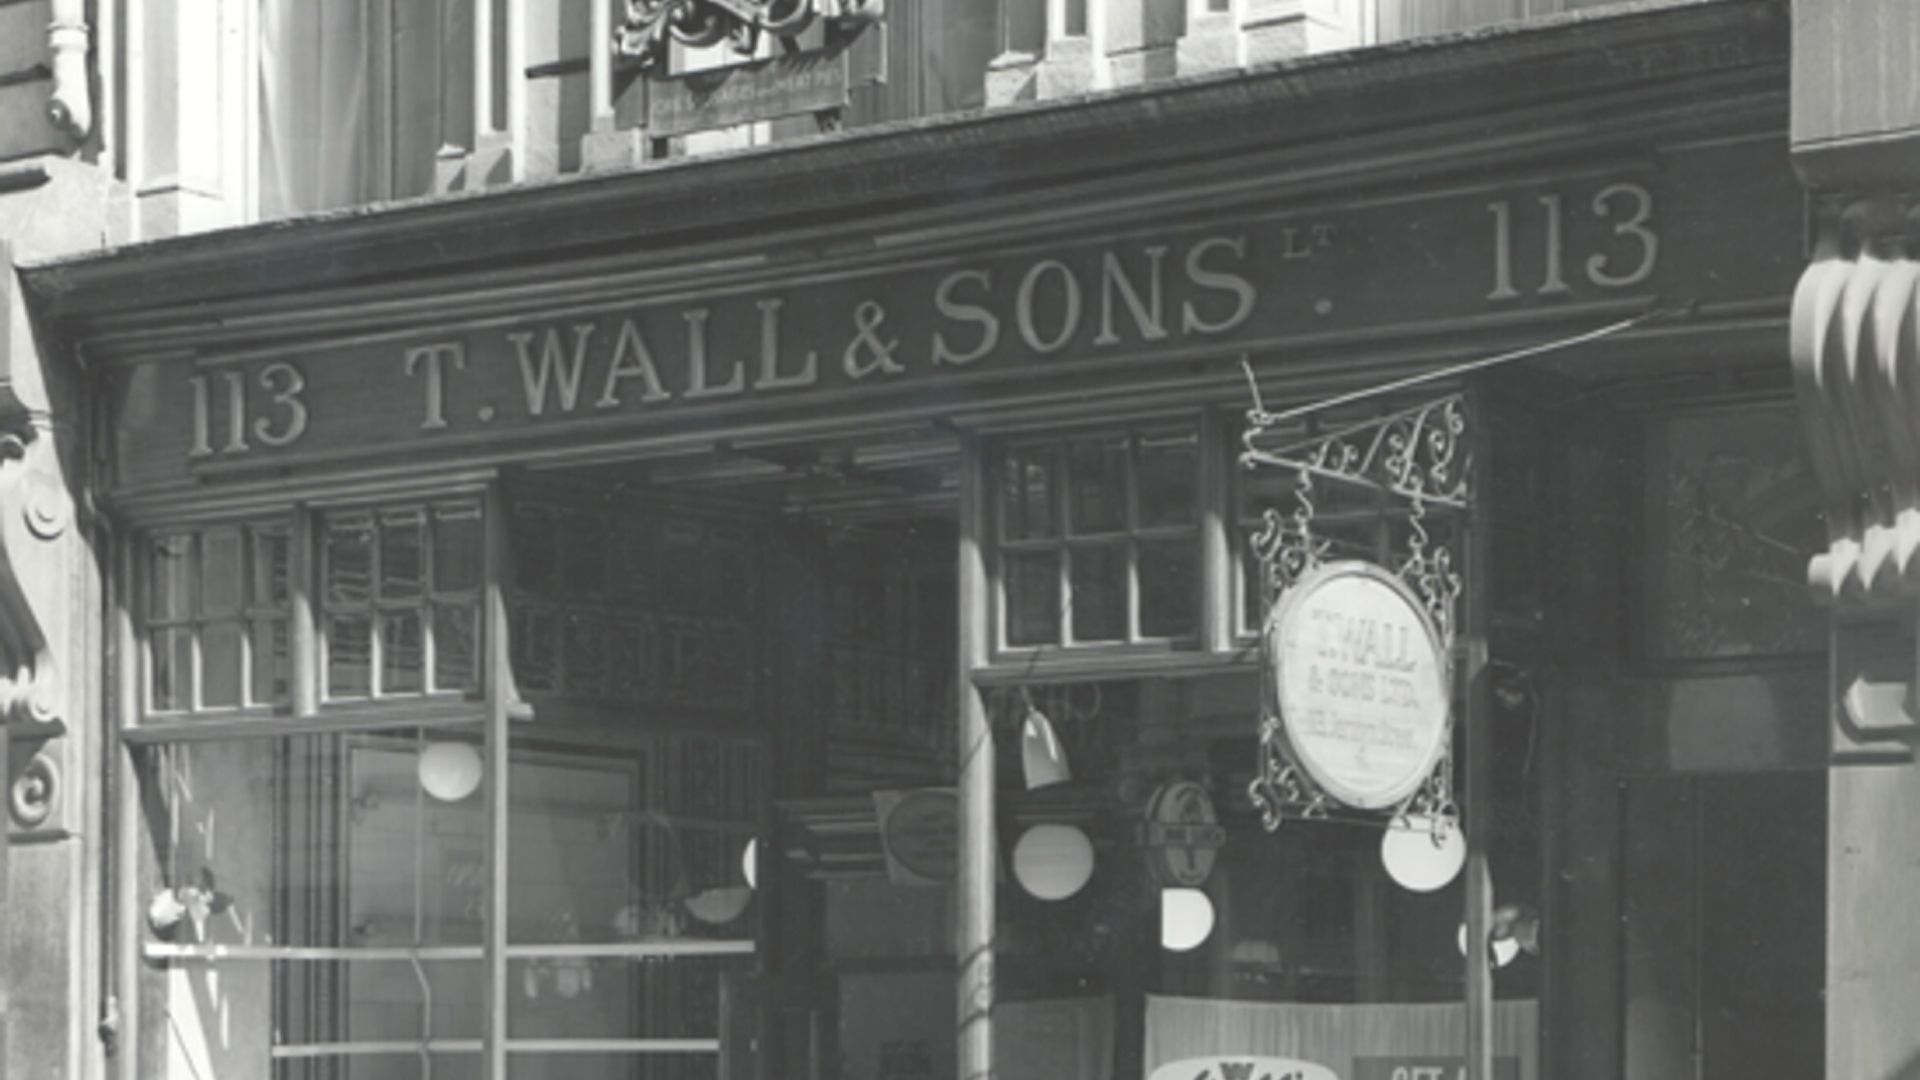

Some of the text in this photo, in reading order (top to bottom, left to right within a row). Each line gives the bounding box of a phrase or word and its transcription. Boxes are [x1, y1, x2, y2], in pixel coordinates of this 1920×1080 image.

[188, 362, 308, 457] 113
[404, 341, 495, 429] T.
[507, 299, 817, 416] WALL
[842, 300, 904, 378] &
[932, 236, 1256, 366] SONS
[1486, 183, 1659, 299] 113
